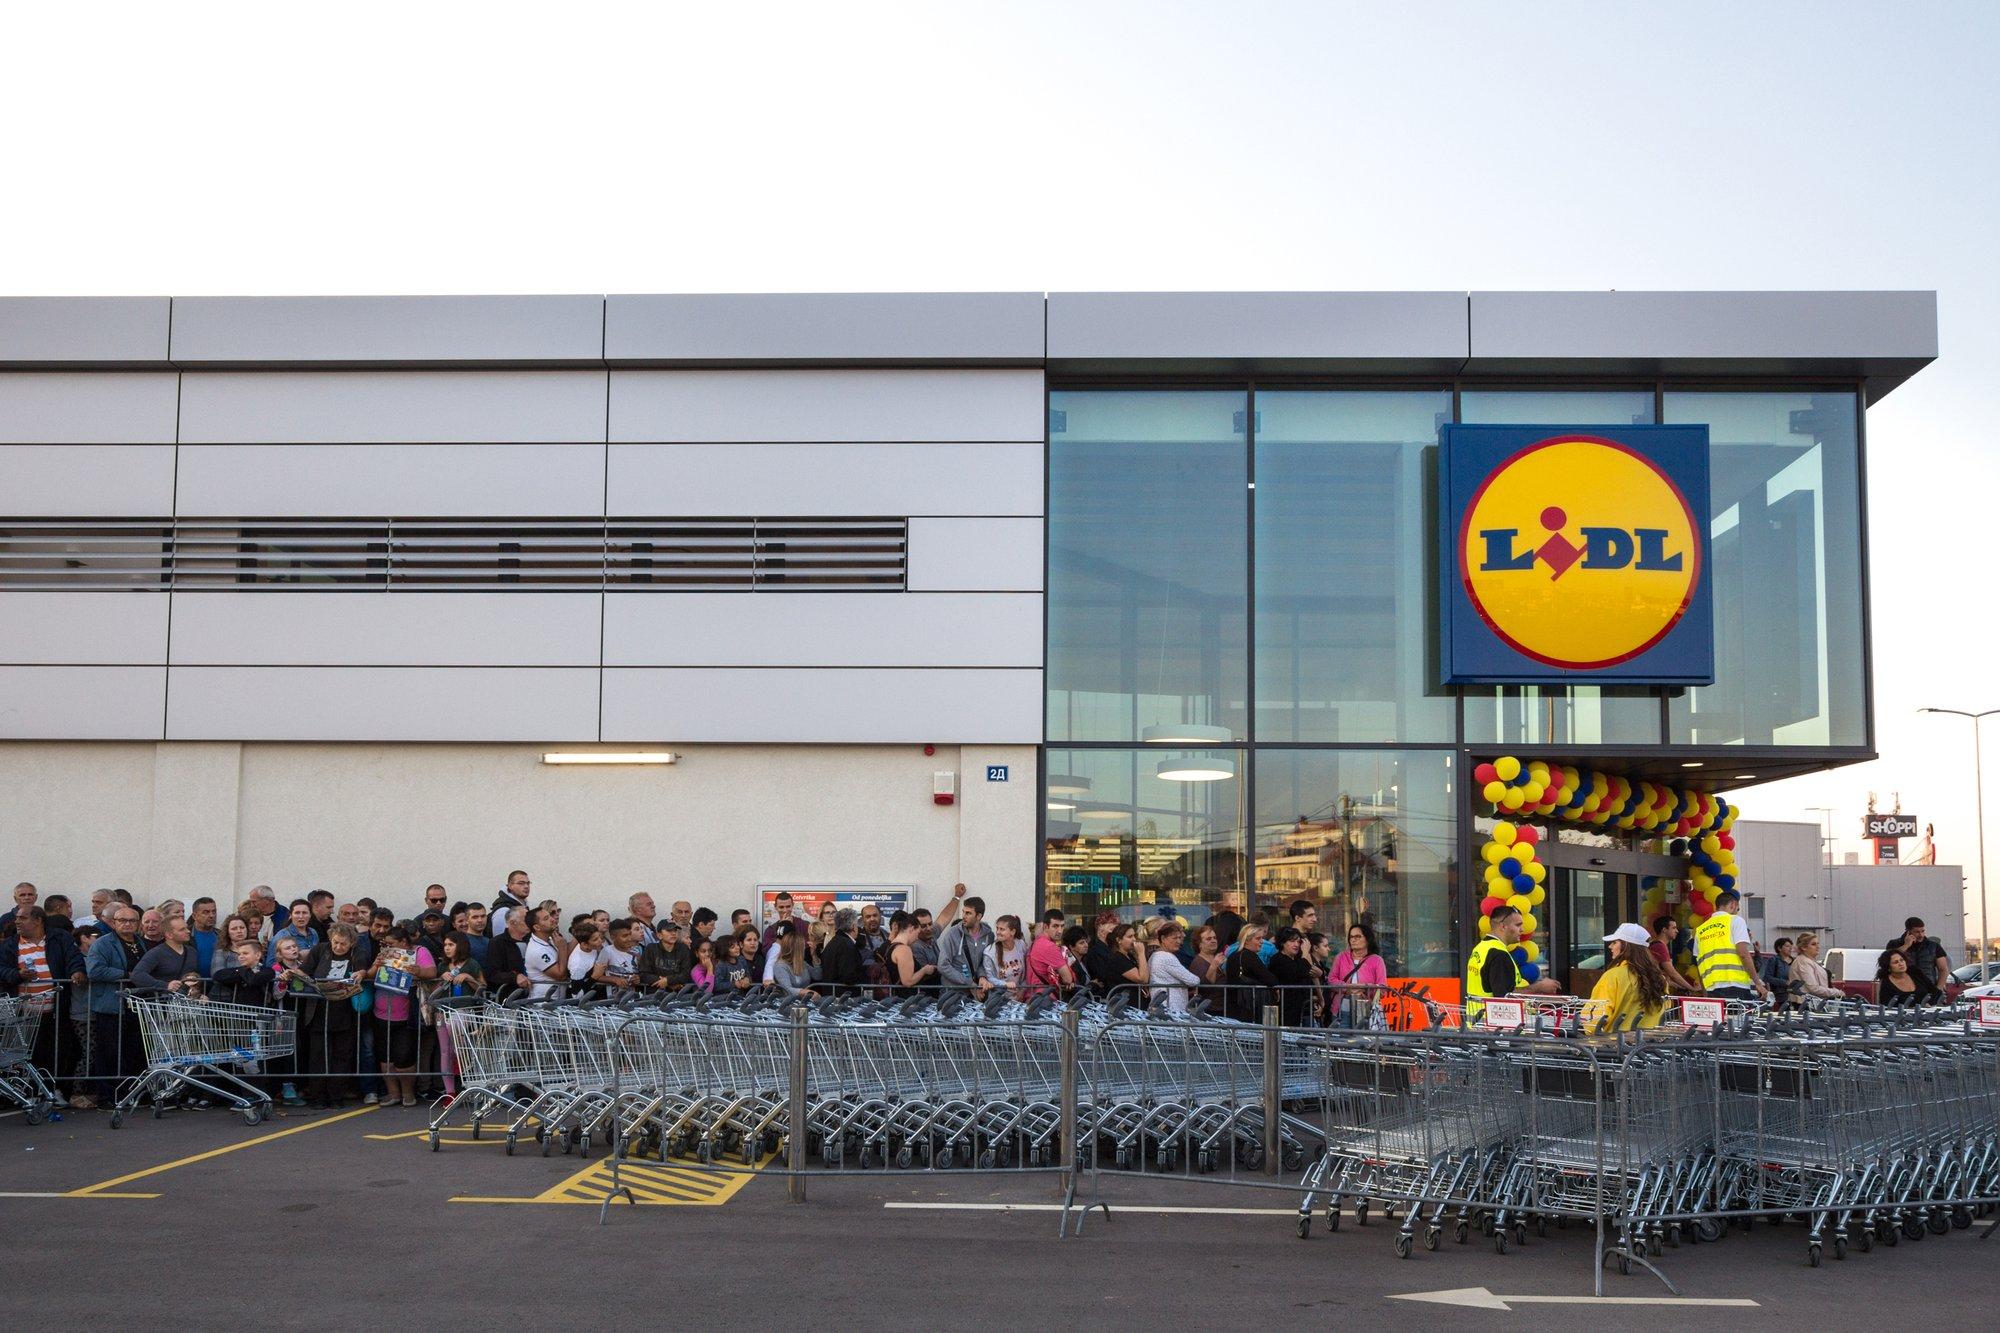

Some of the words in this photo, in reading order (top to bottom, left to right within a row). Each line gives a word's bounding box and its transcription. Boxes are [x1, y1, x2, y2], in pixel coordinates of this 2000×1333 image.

[990, 768, 1005, 781] 2Д
[1869, 817, 1916, 834] SHOPPI
[541, 953, 552, 963] 3
